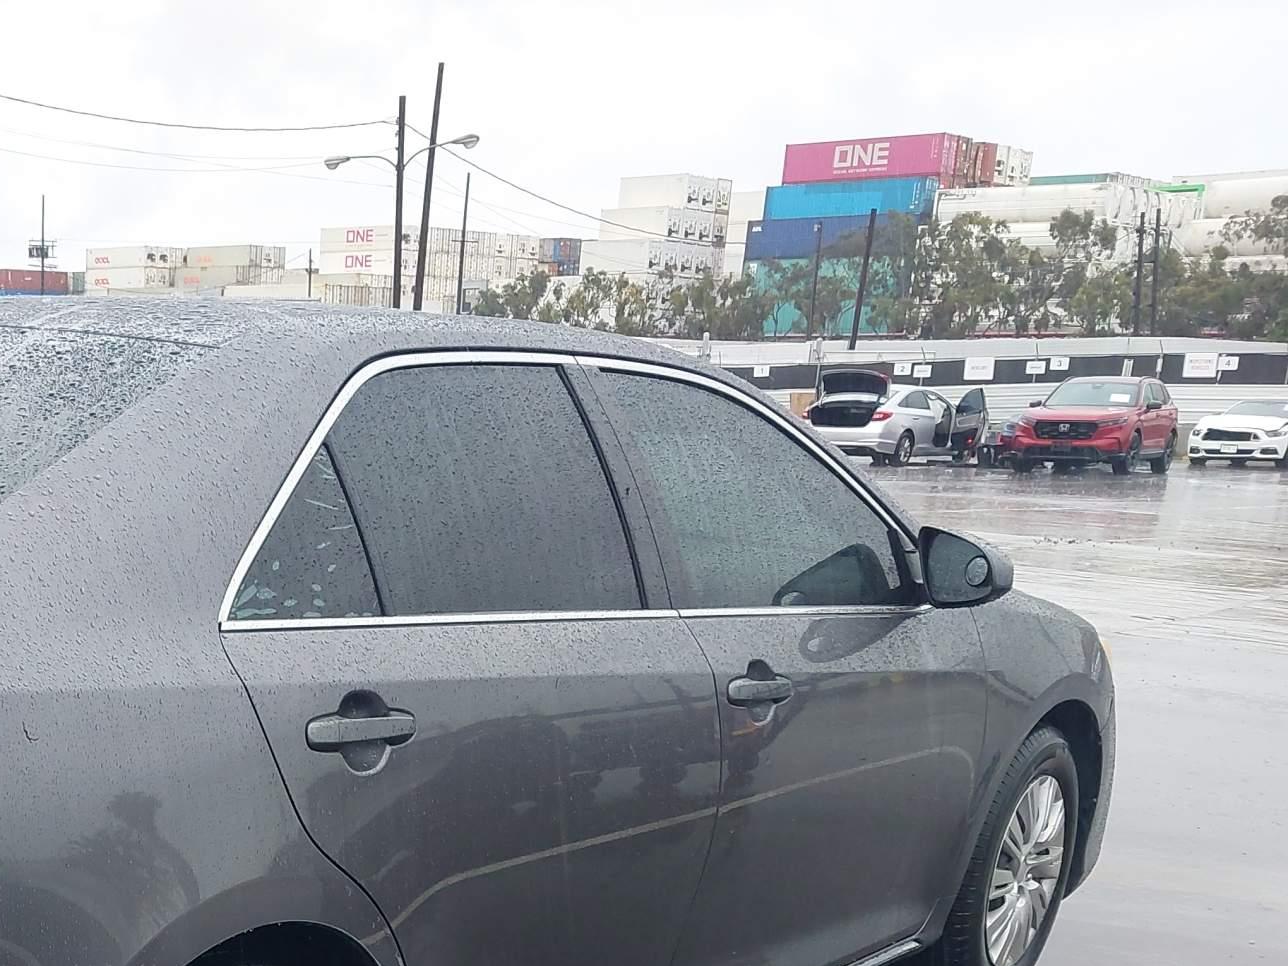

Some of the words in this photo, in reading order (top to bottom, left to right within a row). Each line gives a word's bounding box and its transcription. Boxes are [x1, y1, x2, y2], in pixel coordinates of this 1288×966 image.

[833, 143, 890, 168] ONE
[346, 229, 374, 243] ONE
[344, 255, 373, 268] ONE
